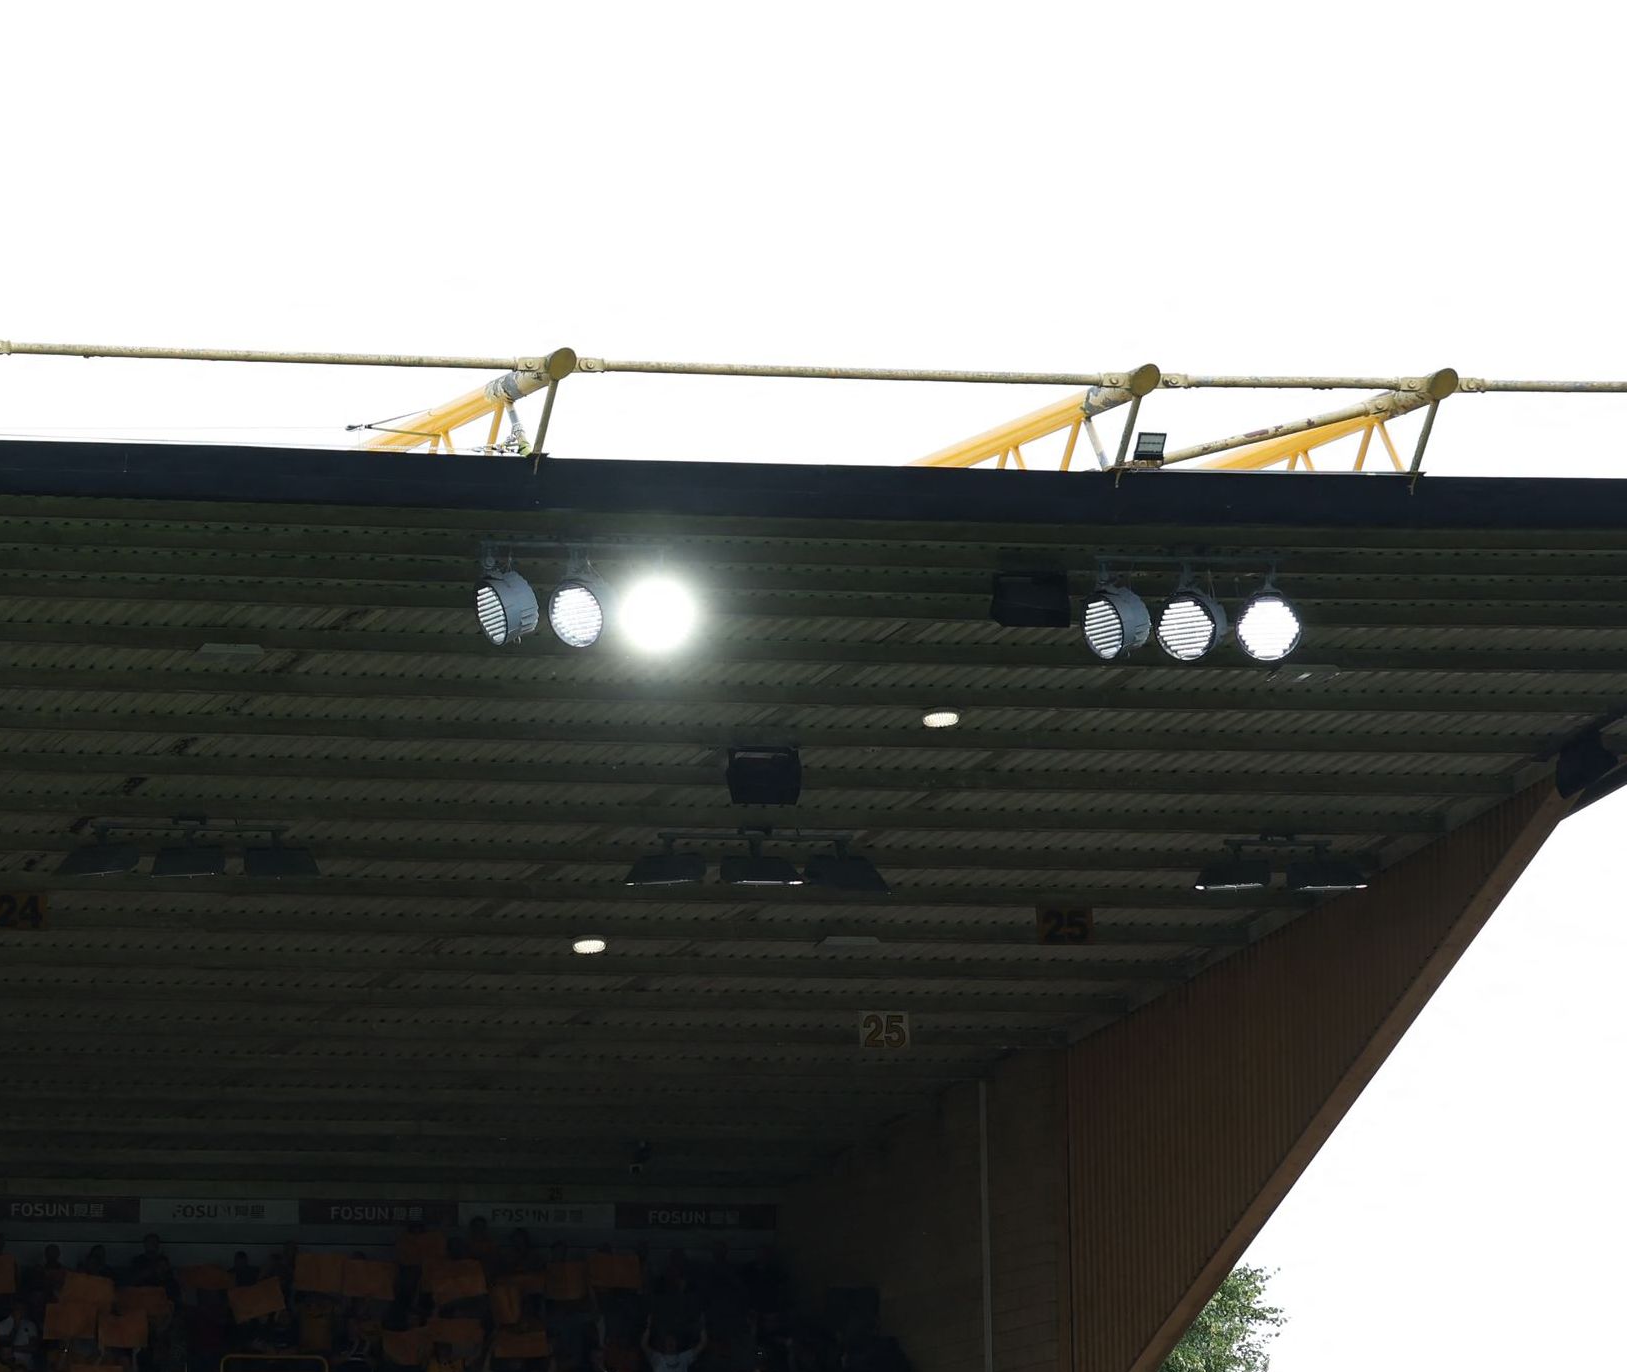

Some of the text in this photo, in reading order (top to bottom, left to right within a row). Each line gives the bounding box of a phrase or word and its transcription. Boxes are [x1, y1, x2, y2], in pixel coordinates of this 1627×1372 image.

[1043, 910, 1091, 944] 25
[864, 1014, 906, 1048] 25
[11, 1203, 69, 1216] FOSUN
[331, 1206, 388, 1220] FOSUN
[649, 1210, 705, 1224] FOSUN
